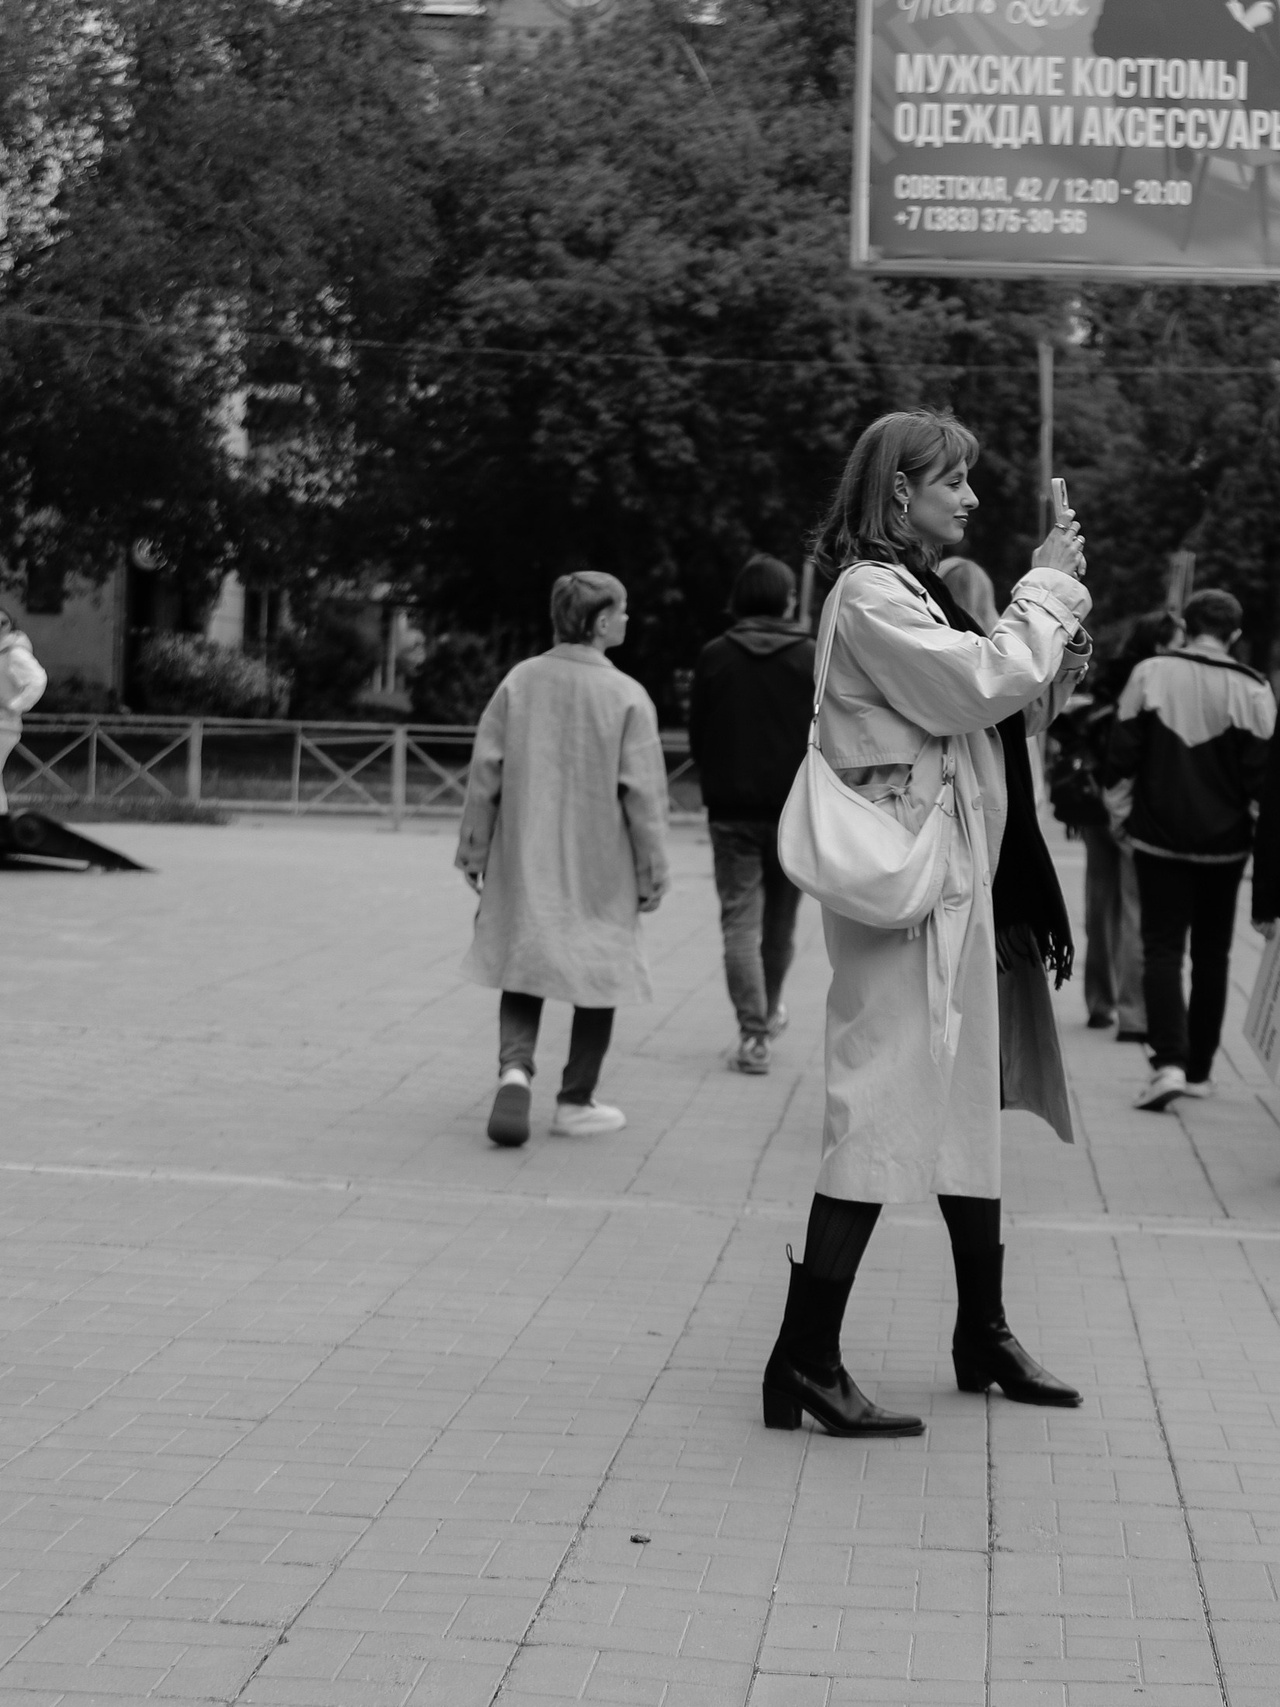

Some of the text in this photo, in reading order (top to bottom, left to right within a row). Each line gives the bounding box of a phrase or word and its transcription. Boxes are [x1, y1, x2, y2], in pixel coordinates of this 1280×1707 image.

[895, 53, 1248, 101] МУЖСКИЕ КОСТЮМЫ
[894, 102, 1044, 149] ОДЕЖДА
[1049, 106, 1074, 146] И
[894, 174, 1013, 204] СОВЕТСКАЯ,
[1014, 176, 1043, 203] 42
[1063, 178, 1119, 204] 12:00
[1133, 179, 1193, 206] 20:00
[894, 205, 922, 232] +7
